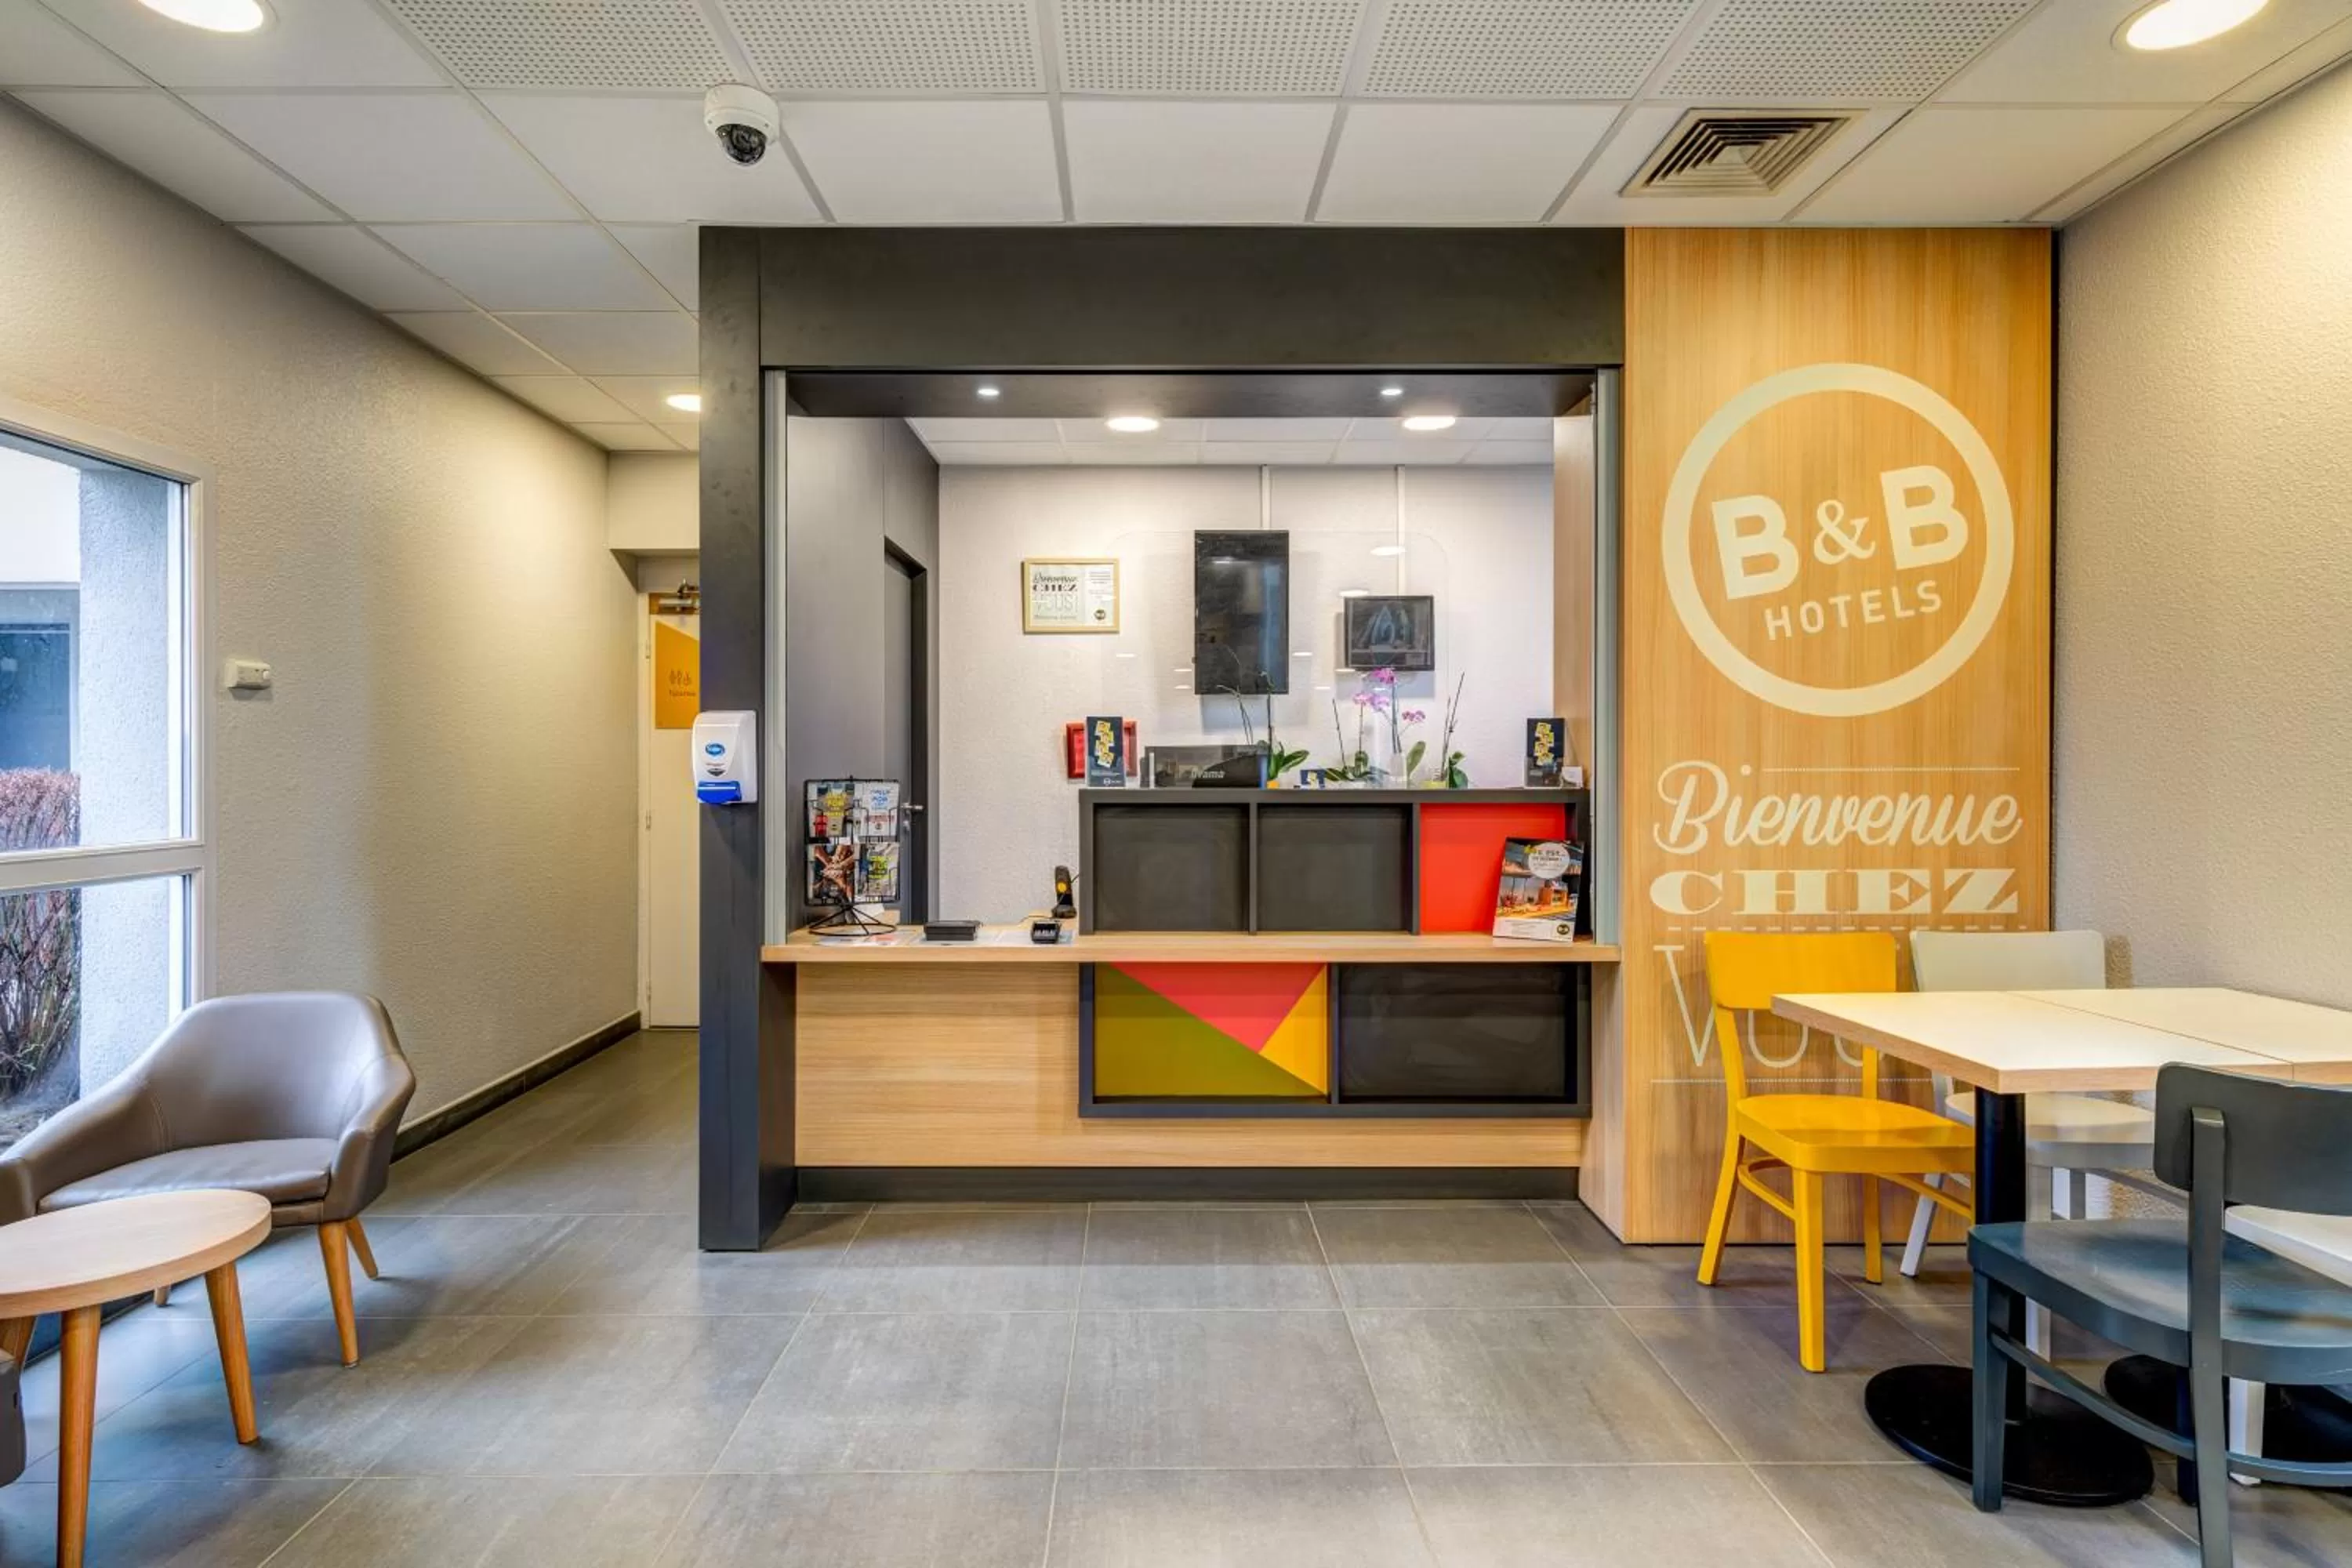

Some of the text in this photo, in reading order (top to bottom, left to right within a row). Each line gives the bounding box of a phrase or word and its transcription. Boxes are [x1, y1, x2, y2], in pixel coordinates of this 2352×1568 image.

[1764, 580, 1942, 641] HOTELS
[1653, 760, 2024, 855] Bienvenue
[1650, 868, 2019, 916] CHEZ
